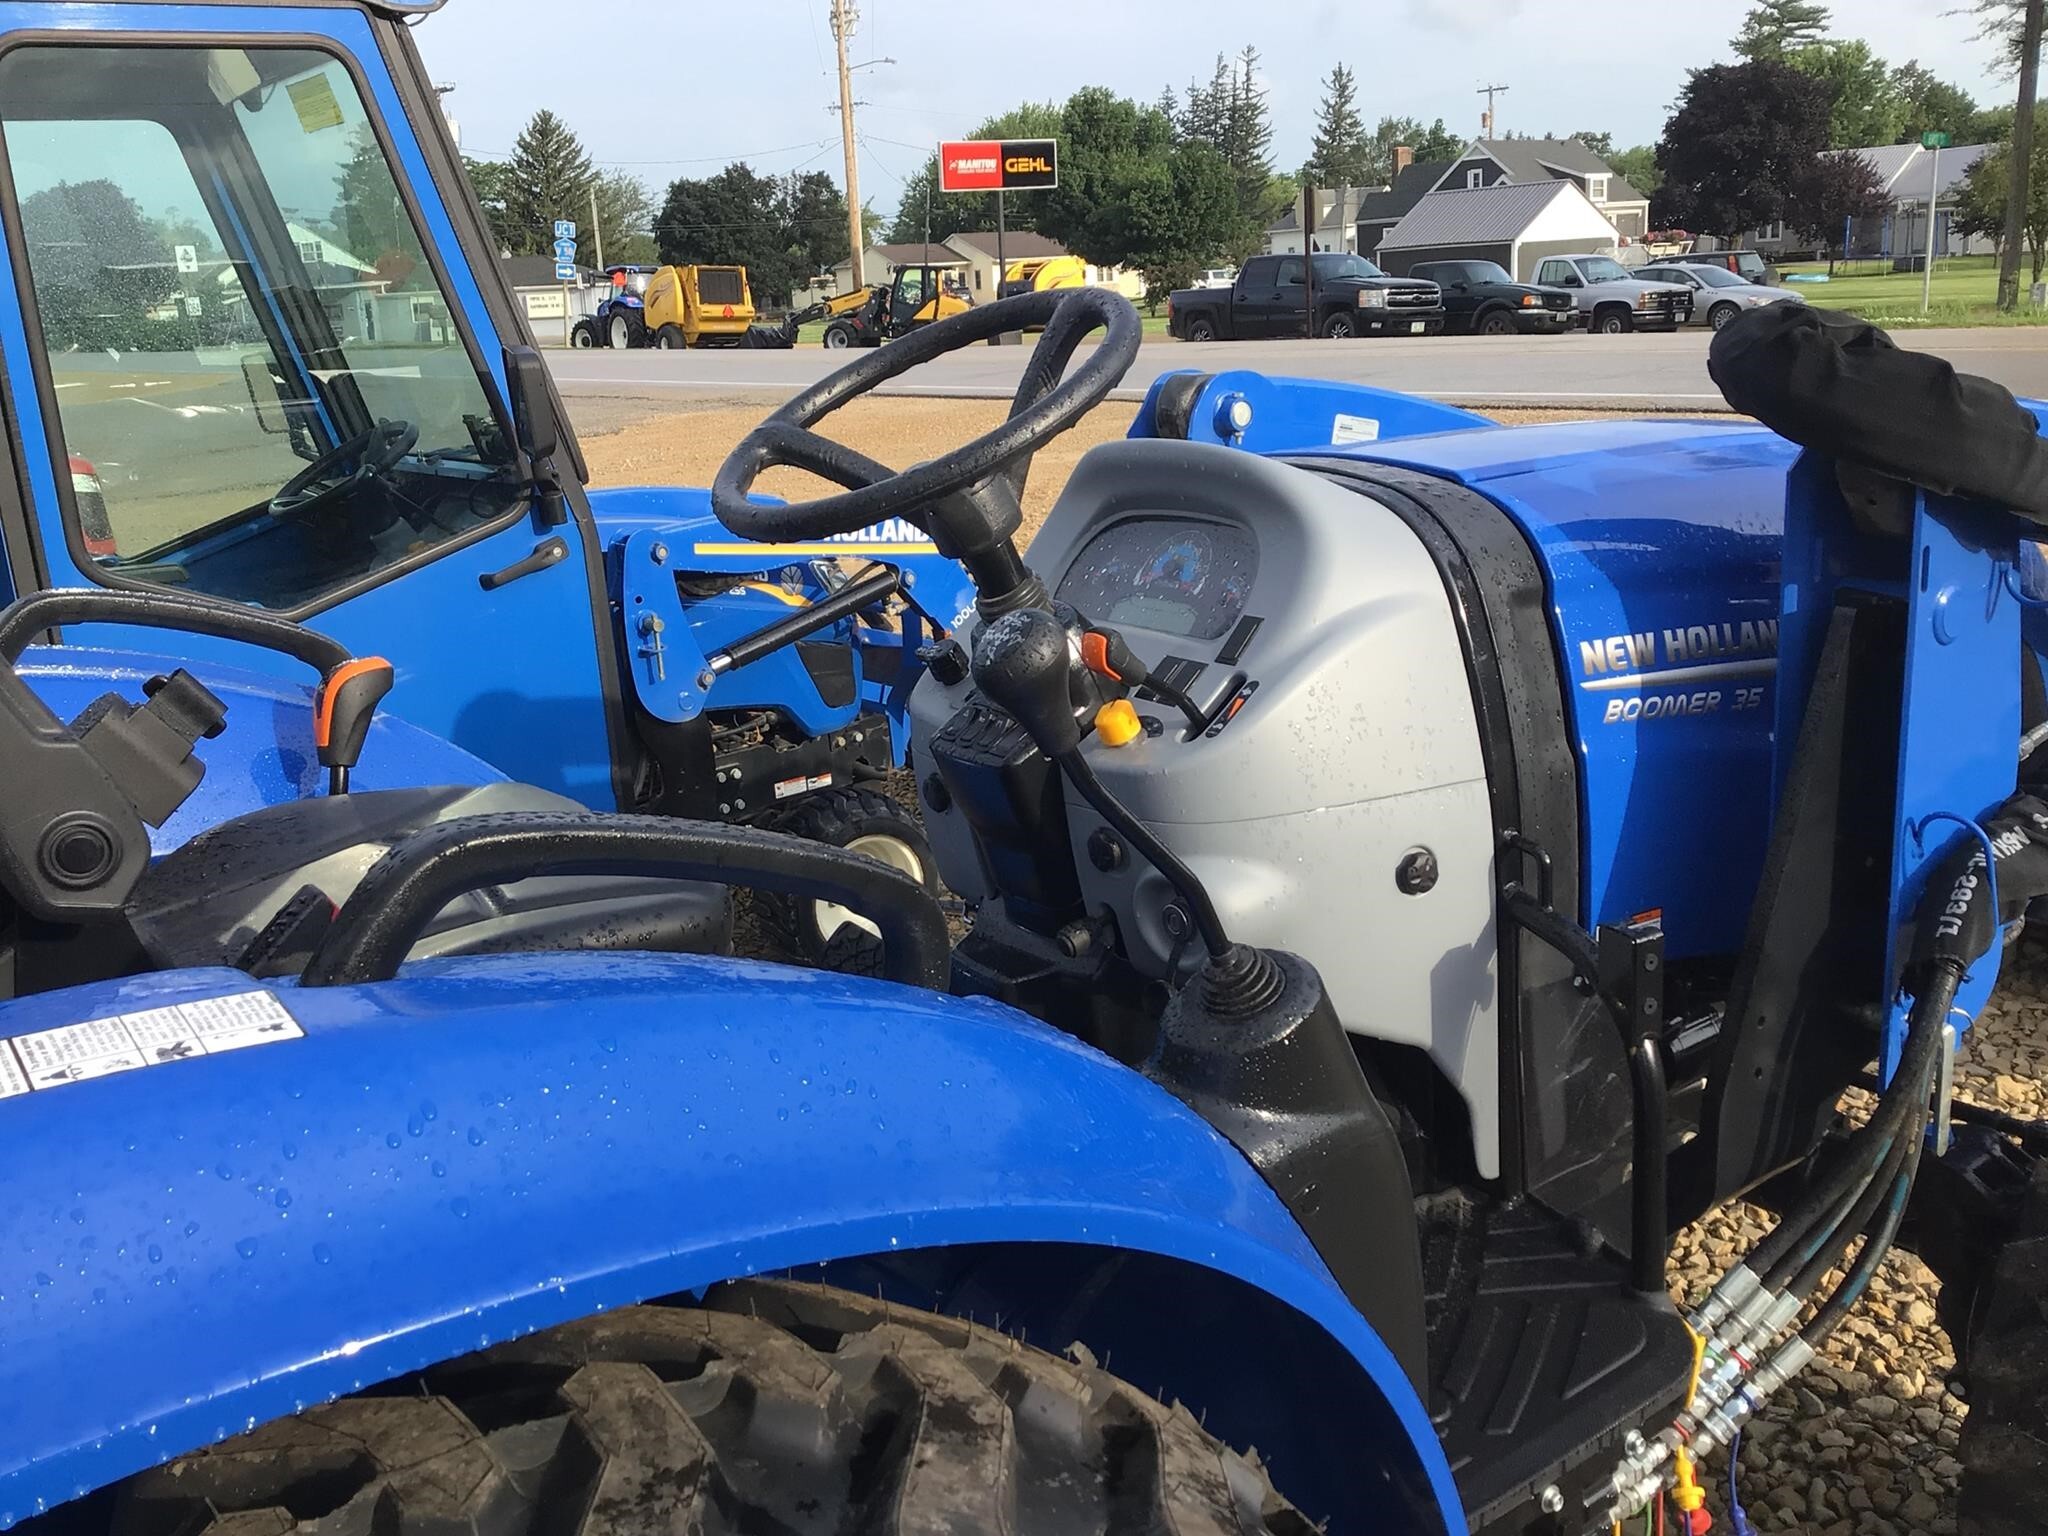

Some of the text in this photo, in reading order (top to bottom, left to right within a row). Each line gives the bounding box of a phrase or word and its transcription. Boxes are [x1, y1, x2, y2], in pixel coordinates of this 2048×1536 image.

[957, 159, 997, 170] MANITOU
[1005, 157, 1053, 173] GEHL
[557, 223, 574, 235] JCT
[1579, 617, 1780, 676] NEW HOLLAN
[1602, 687, 1765, 725] BOOMER 35
